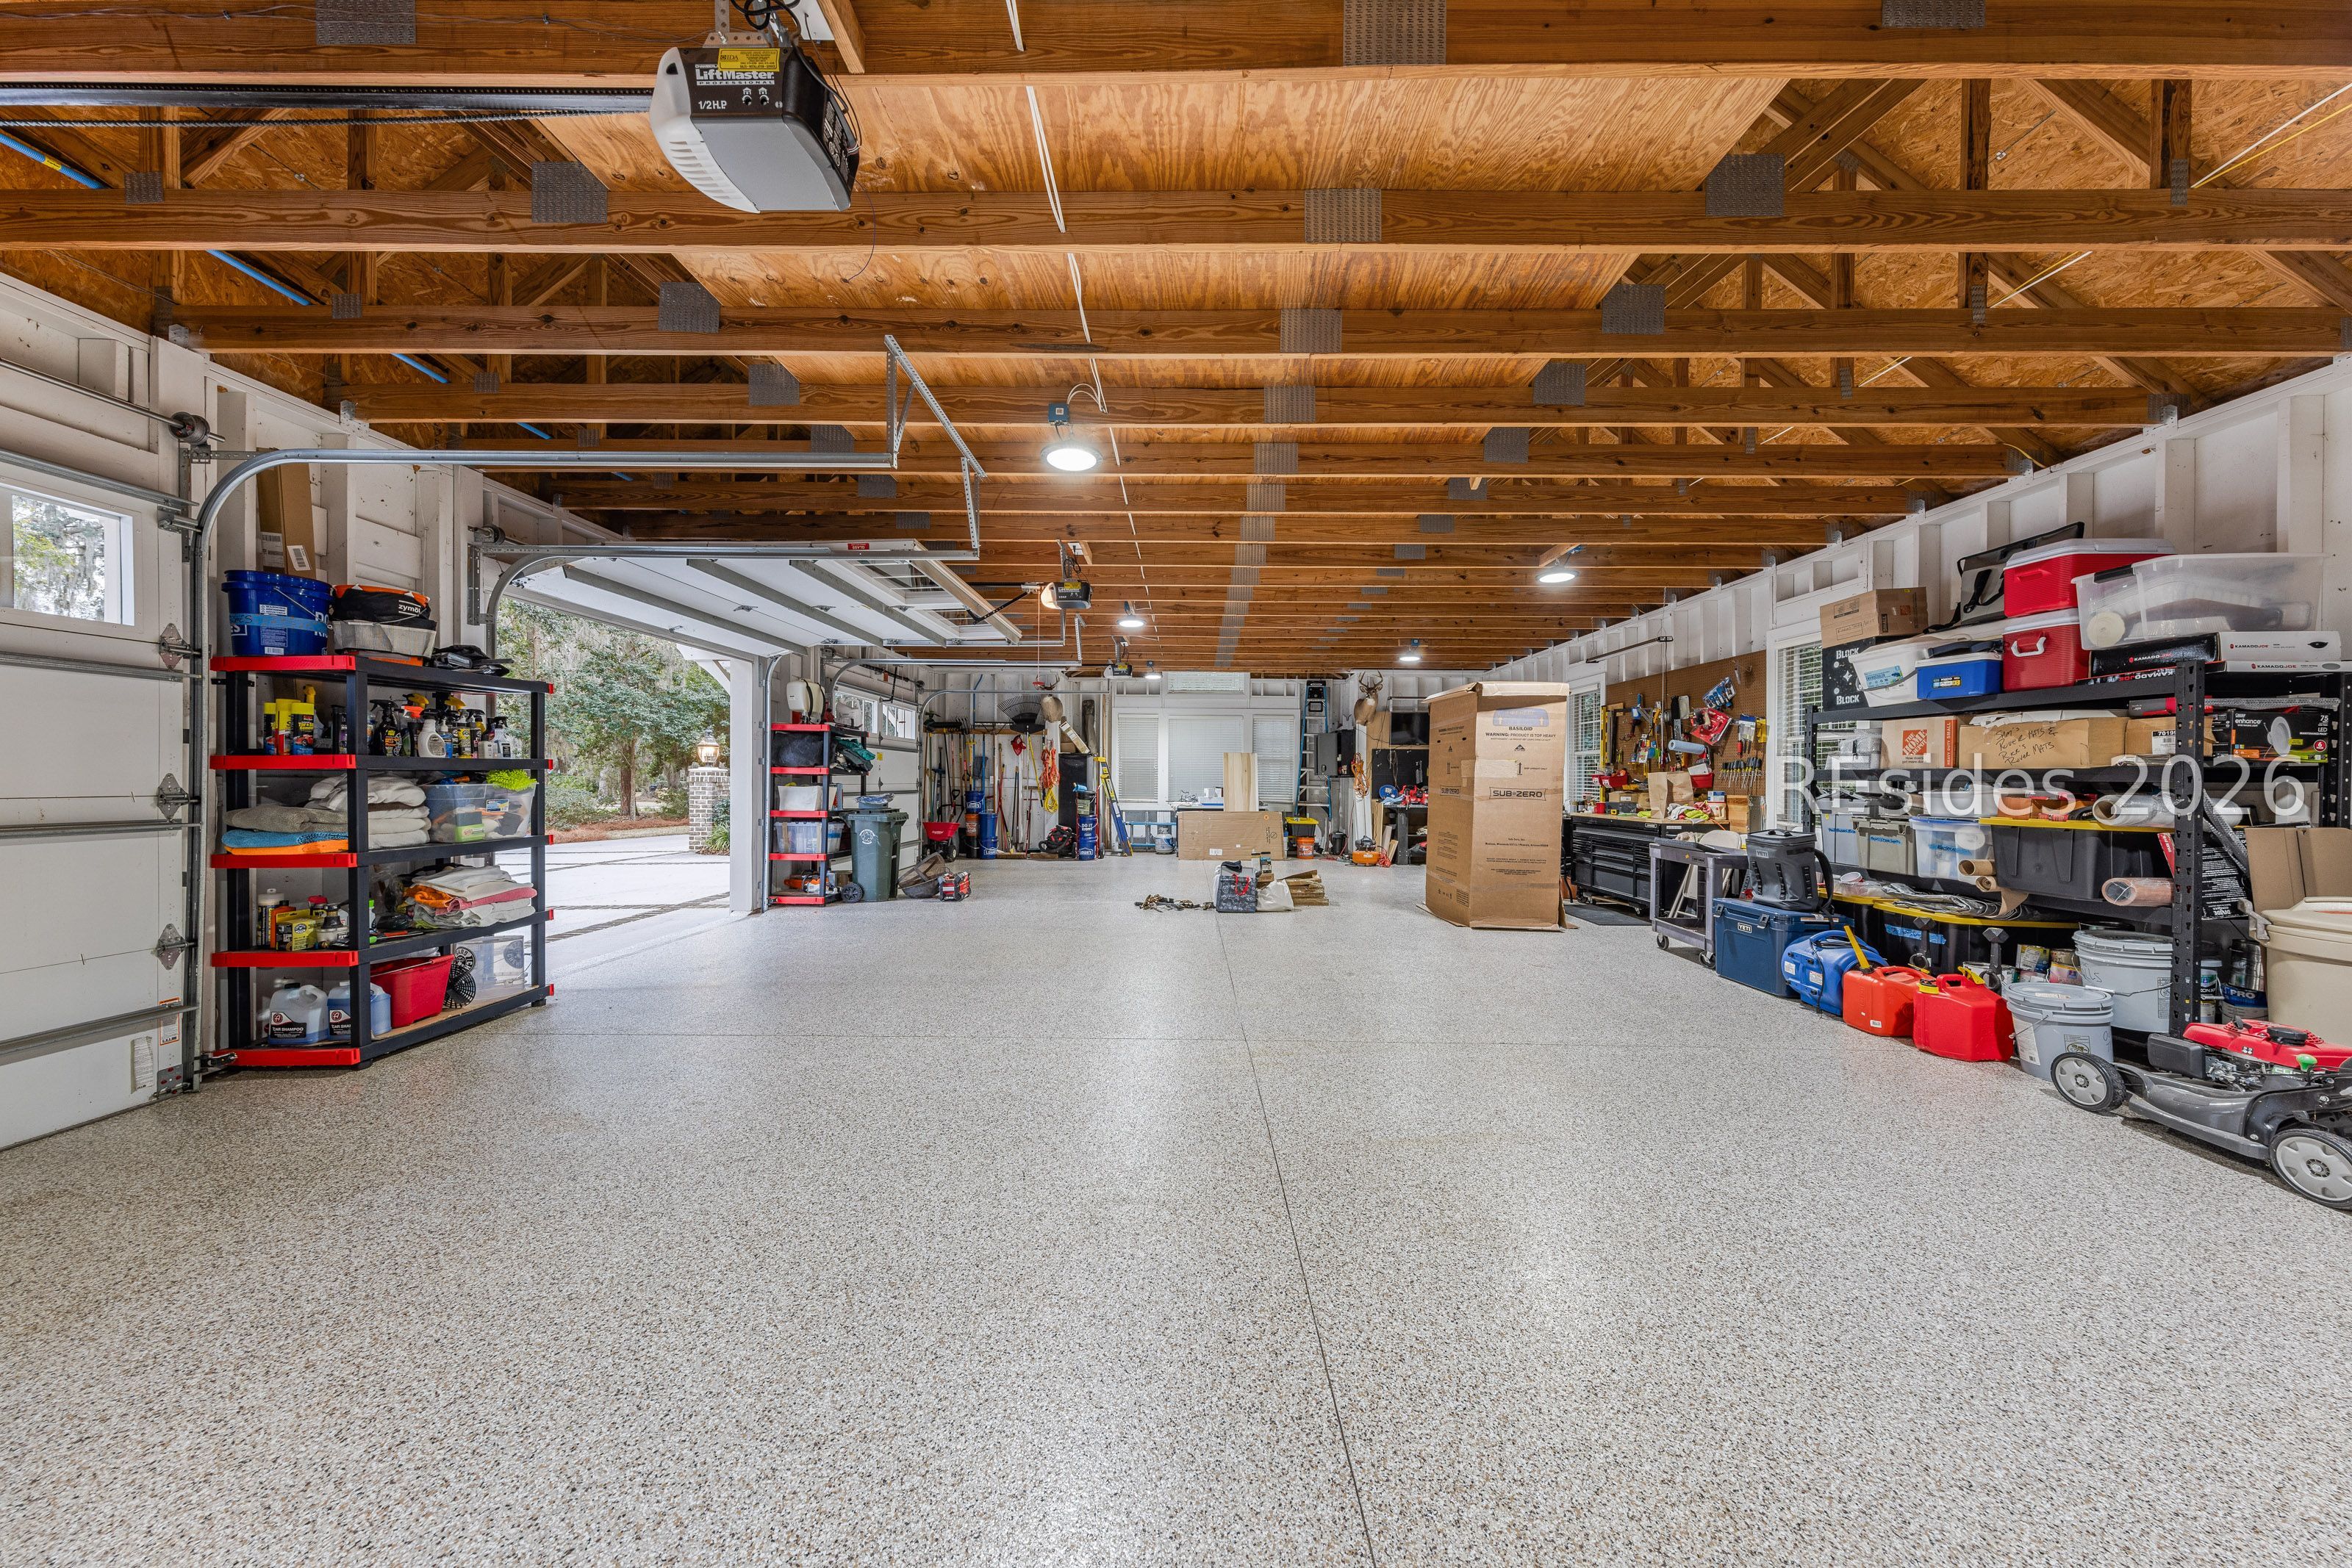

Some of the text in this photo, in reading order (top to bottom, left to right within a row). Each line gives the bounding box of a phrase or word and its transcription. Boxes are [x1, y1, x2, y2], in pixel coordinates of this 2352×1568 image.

[695, 69, 774, 79] LiftMaster
[398, 604, 420, 614] zymöl
[1903, 730, 1926, 755] HOME
[1905, 733, 1915, 742] THE
[1912, 739, 1926, 755] DEPOT
[1739, 924, 1751, 932] YETI
[2230, 989, 2256, 999] PRO
